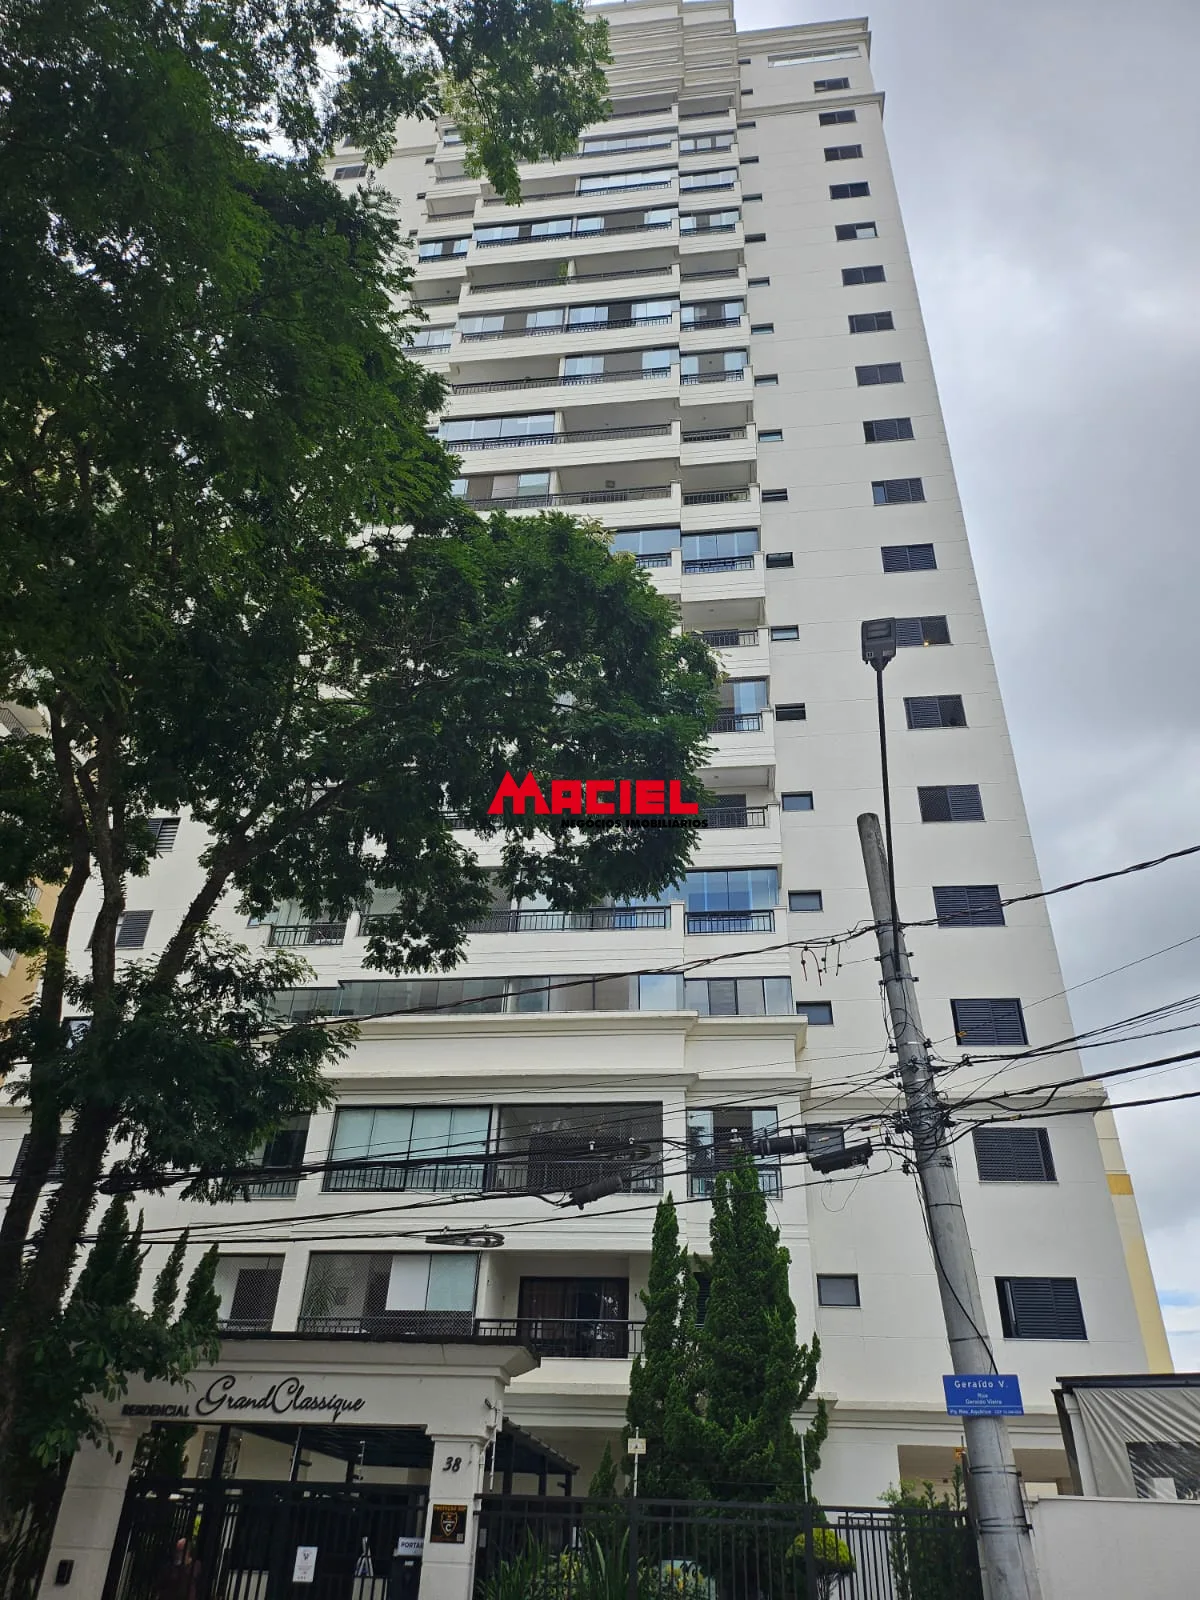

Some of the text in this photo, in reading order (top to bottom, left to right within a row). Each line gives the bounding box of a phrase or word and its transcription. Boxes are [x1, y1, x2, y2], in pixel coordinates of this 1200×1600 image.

[954, 1380, 994, 1388] Geraldo
[121, 1404, 190, 1417] RESIDENCIAL
[442, 1456, 462, 1472] 38
